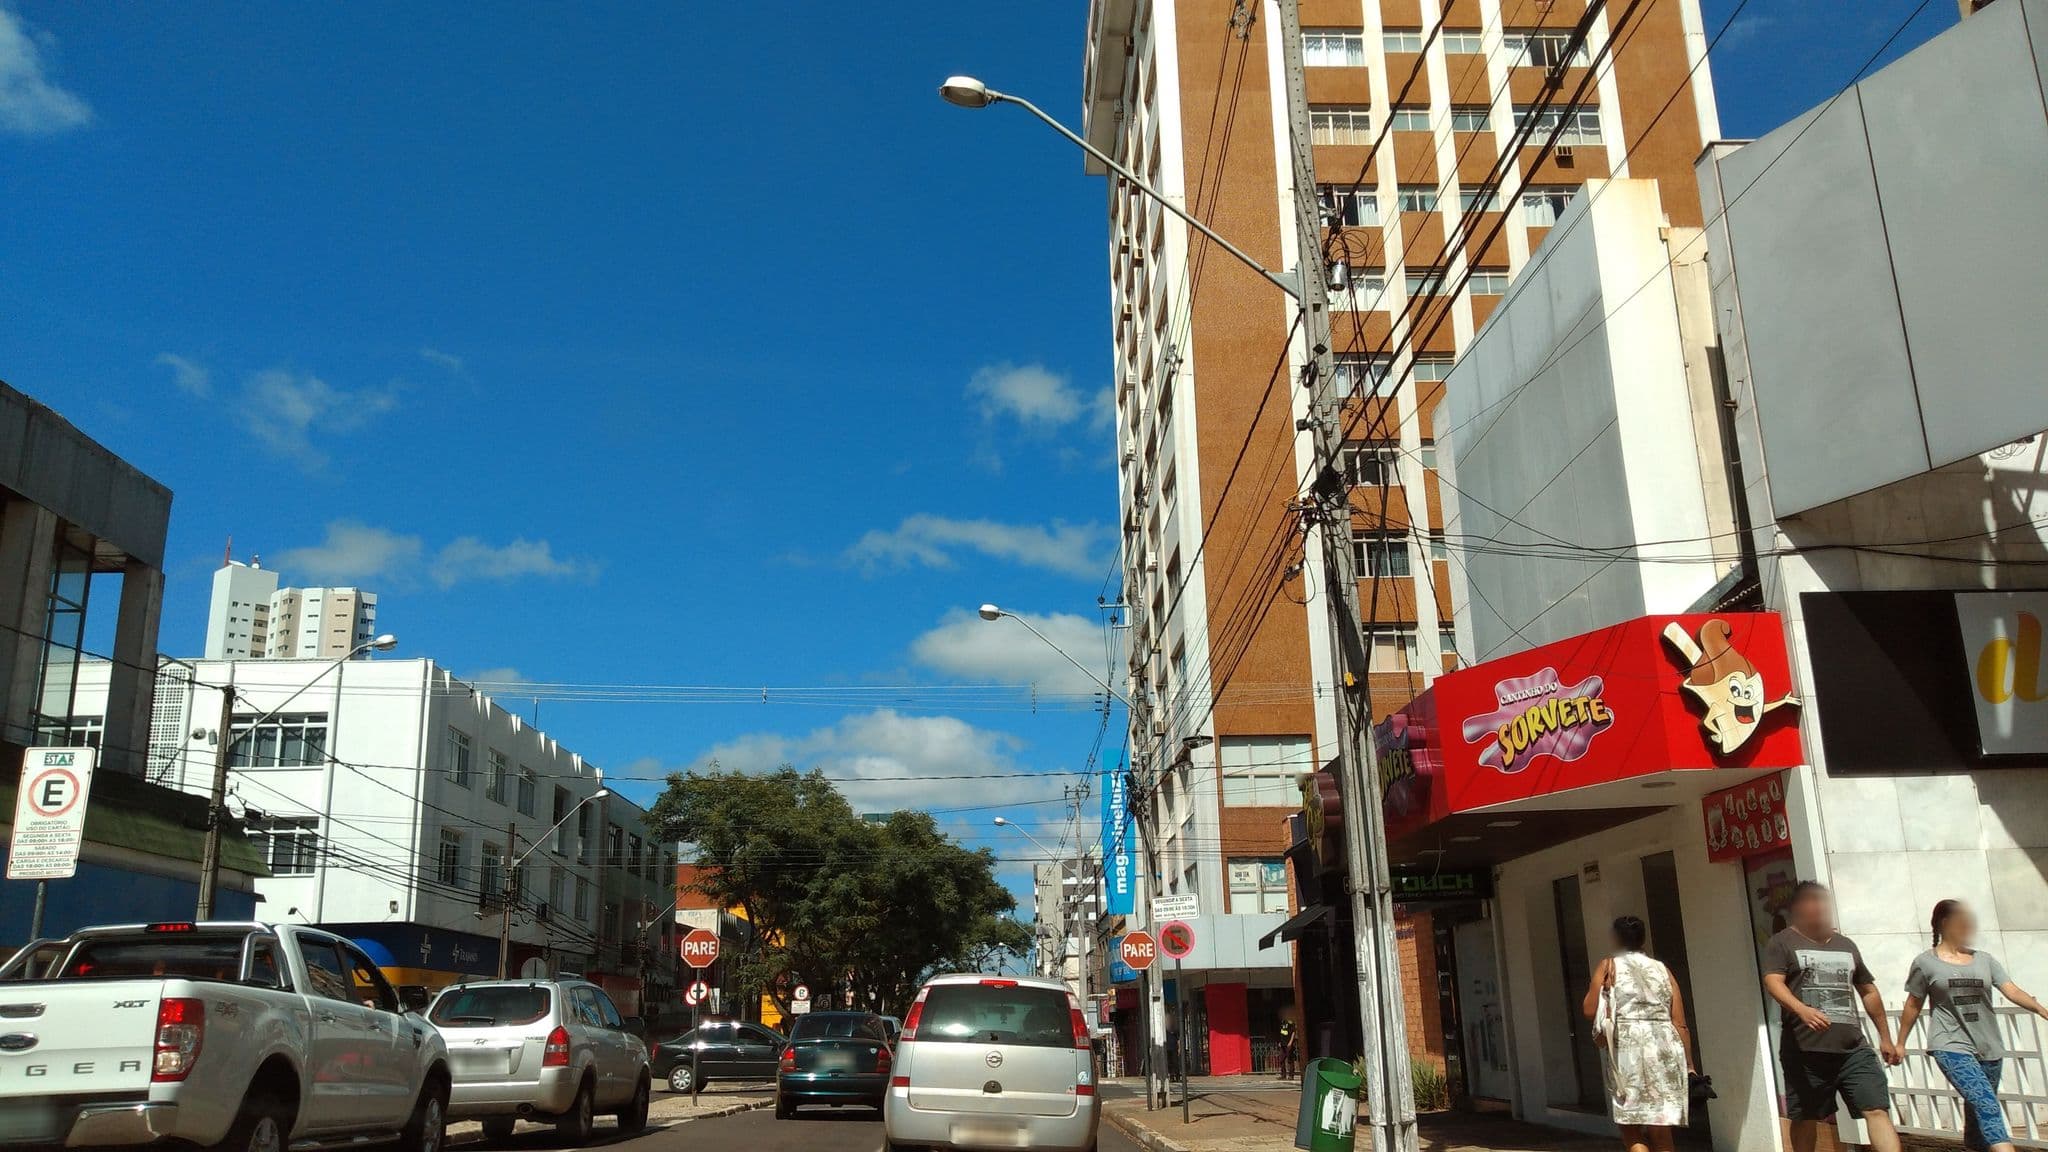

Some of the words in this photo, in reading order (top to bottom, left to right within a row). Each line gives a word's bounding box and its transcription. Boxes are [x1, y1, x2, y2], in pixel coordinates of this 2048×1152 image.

[1501, 685, 1543, 705] CANTINHO
[1544, 682, 1558, 694] DO
[1498, 695, 1611, 768] SORVETE
[44, 753, 75, 766] ESTAR
[42, 780, 66, 806] E
[684, 941, 716, 956] PARE
[1123, 943, 1153, 958] PARE
[113, 1000, 151, 1008] XLT
